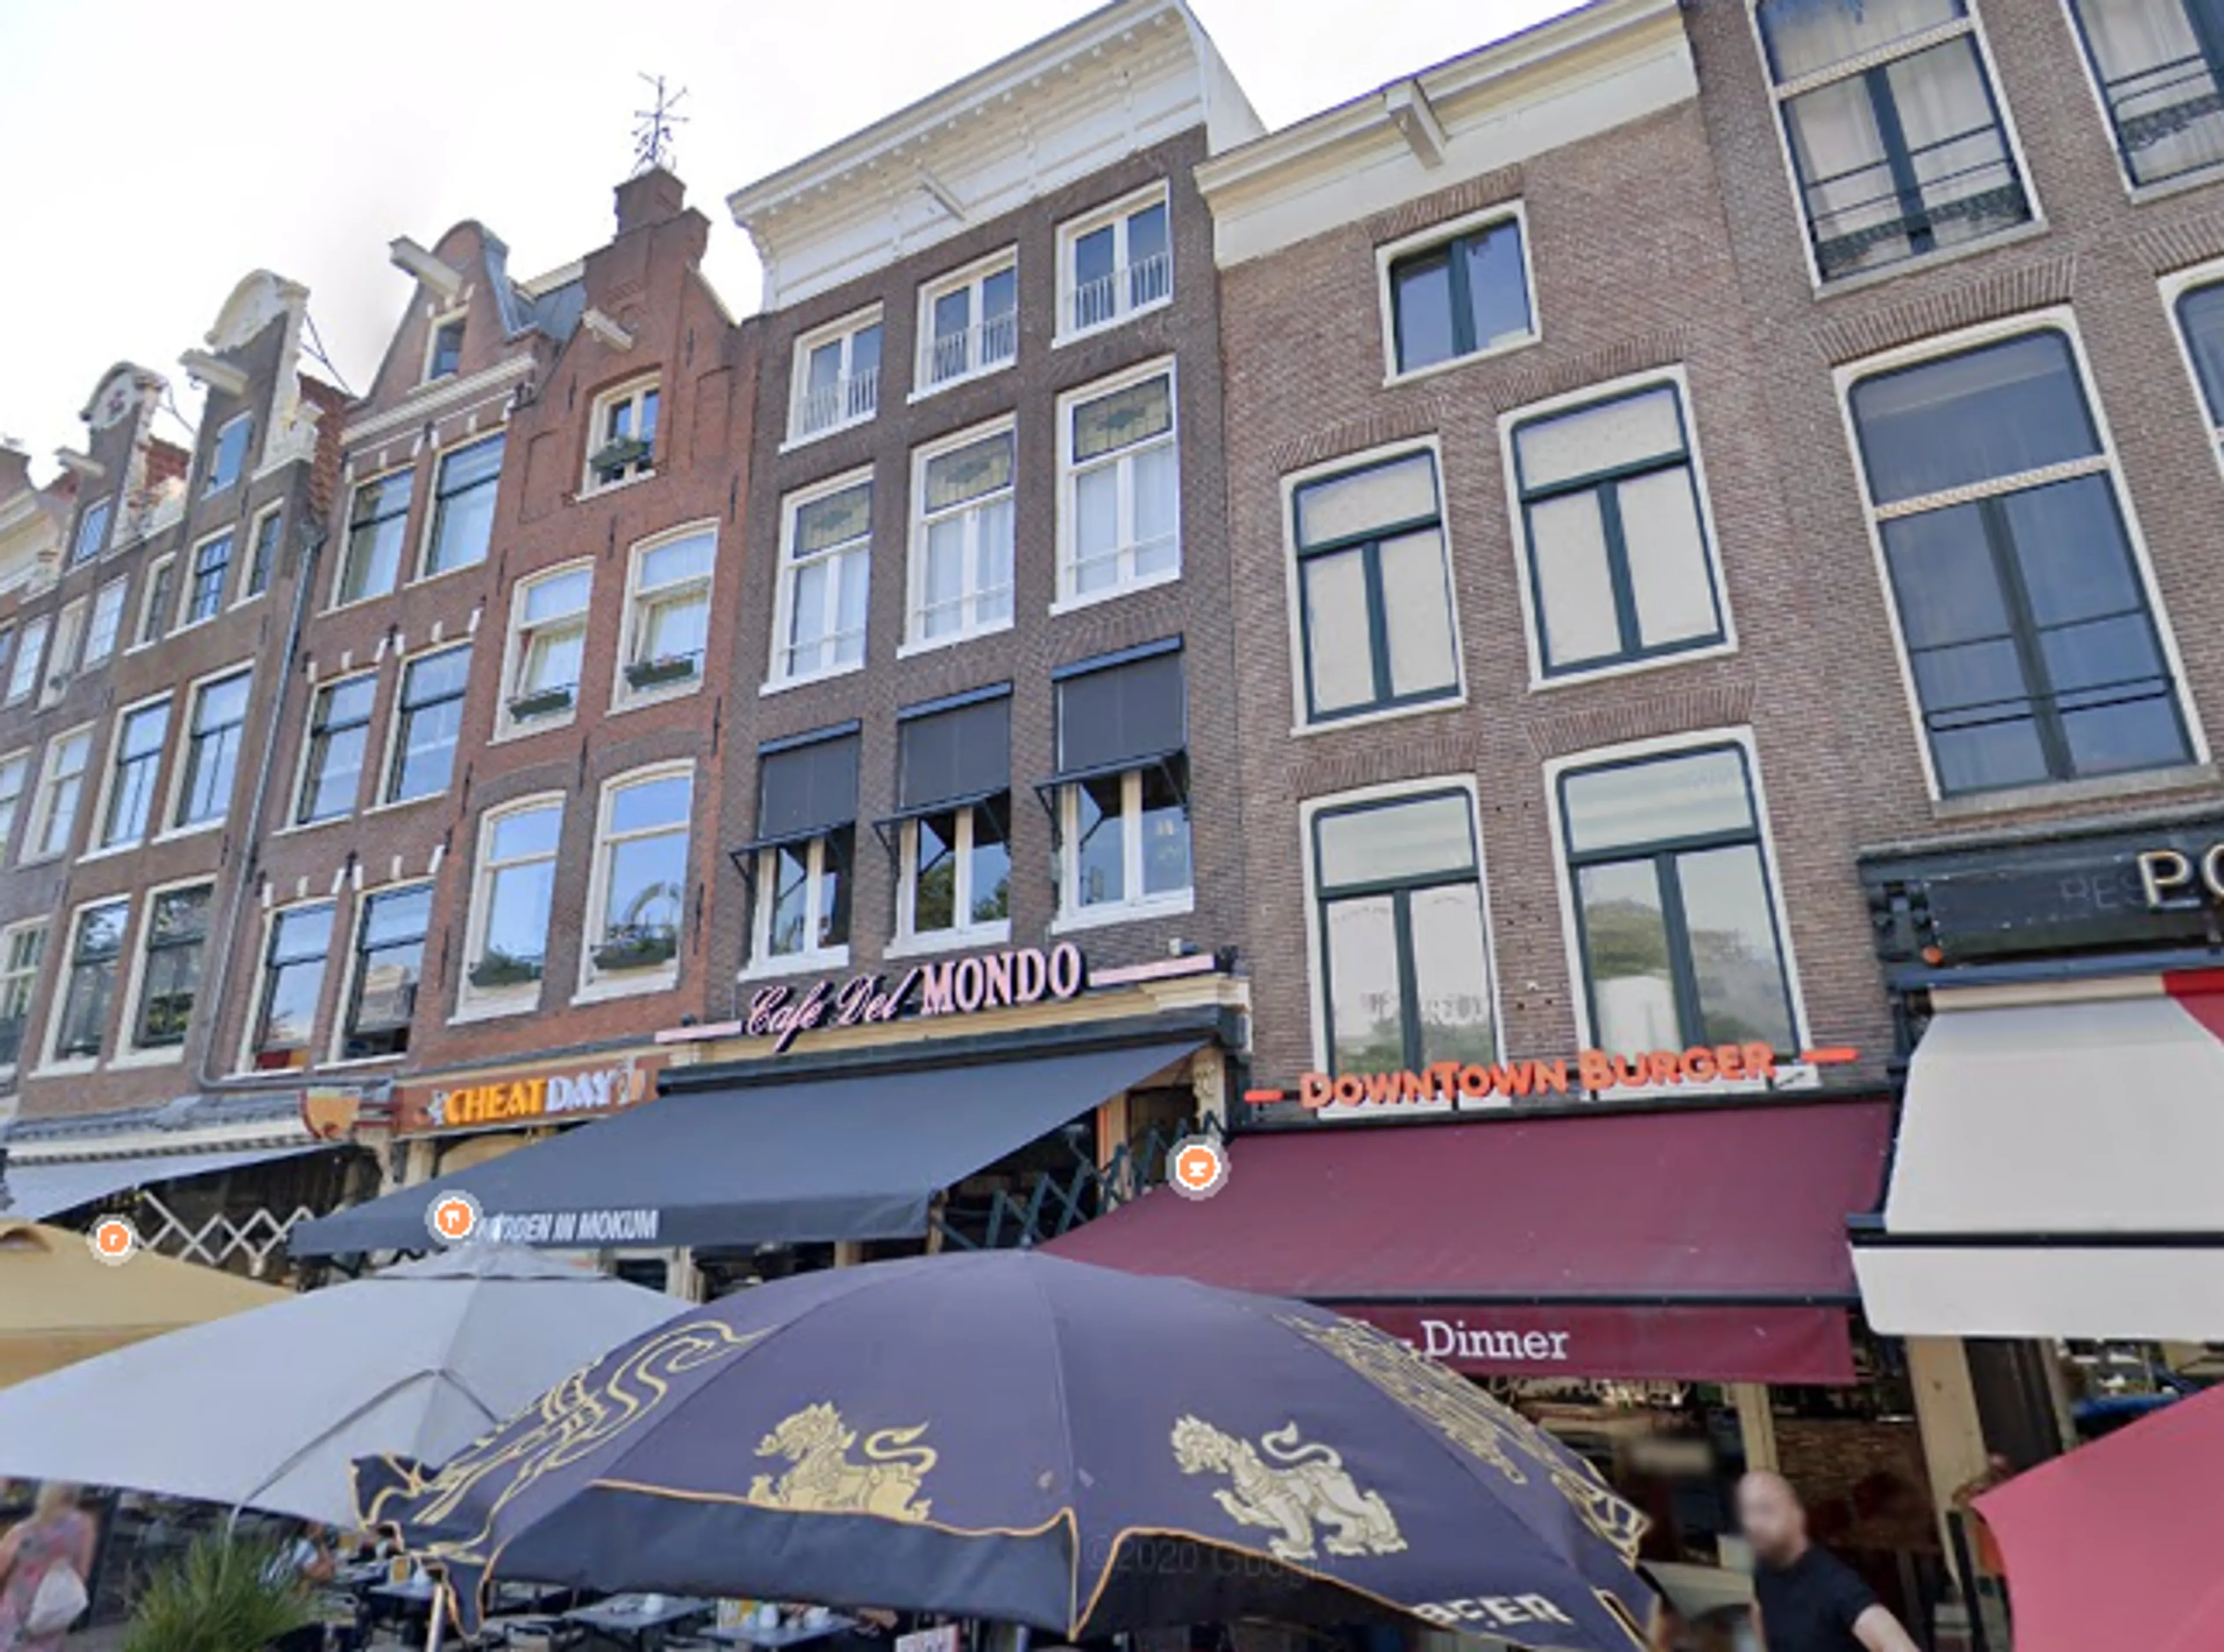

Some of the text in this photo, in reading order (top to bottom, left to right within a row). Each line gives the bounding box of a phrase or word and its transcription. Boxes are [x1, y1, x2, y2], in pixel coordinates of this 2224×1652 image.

[836, 967, 923, 1025] Del
[920, 941, 1082, 1015] MONDO
[1577, 1042, 1776, 1090] BURGER
[553, 1214, 576, 1241] IN
[576, 1209, 659, 1241] MOKUM
[1420, 1320, 1568, 1359] Dinner
